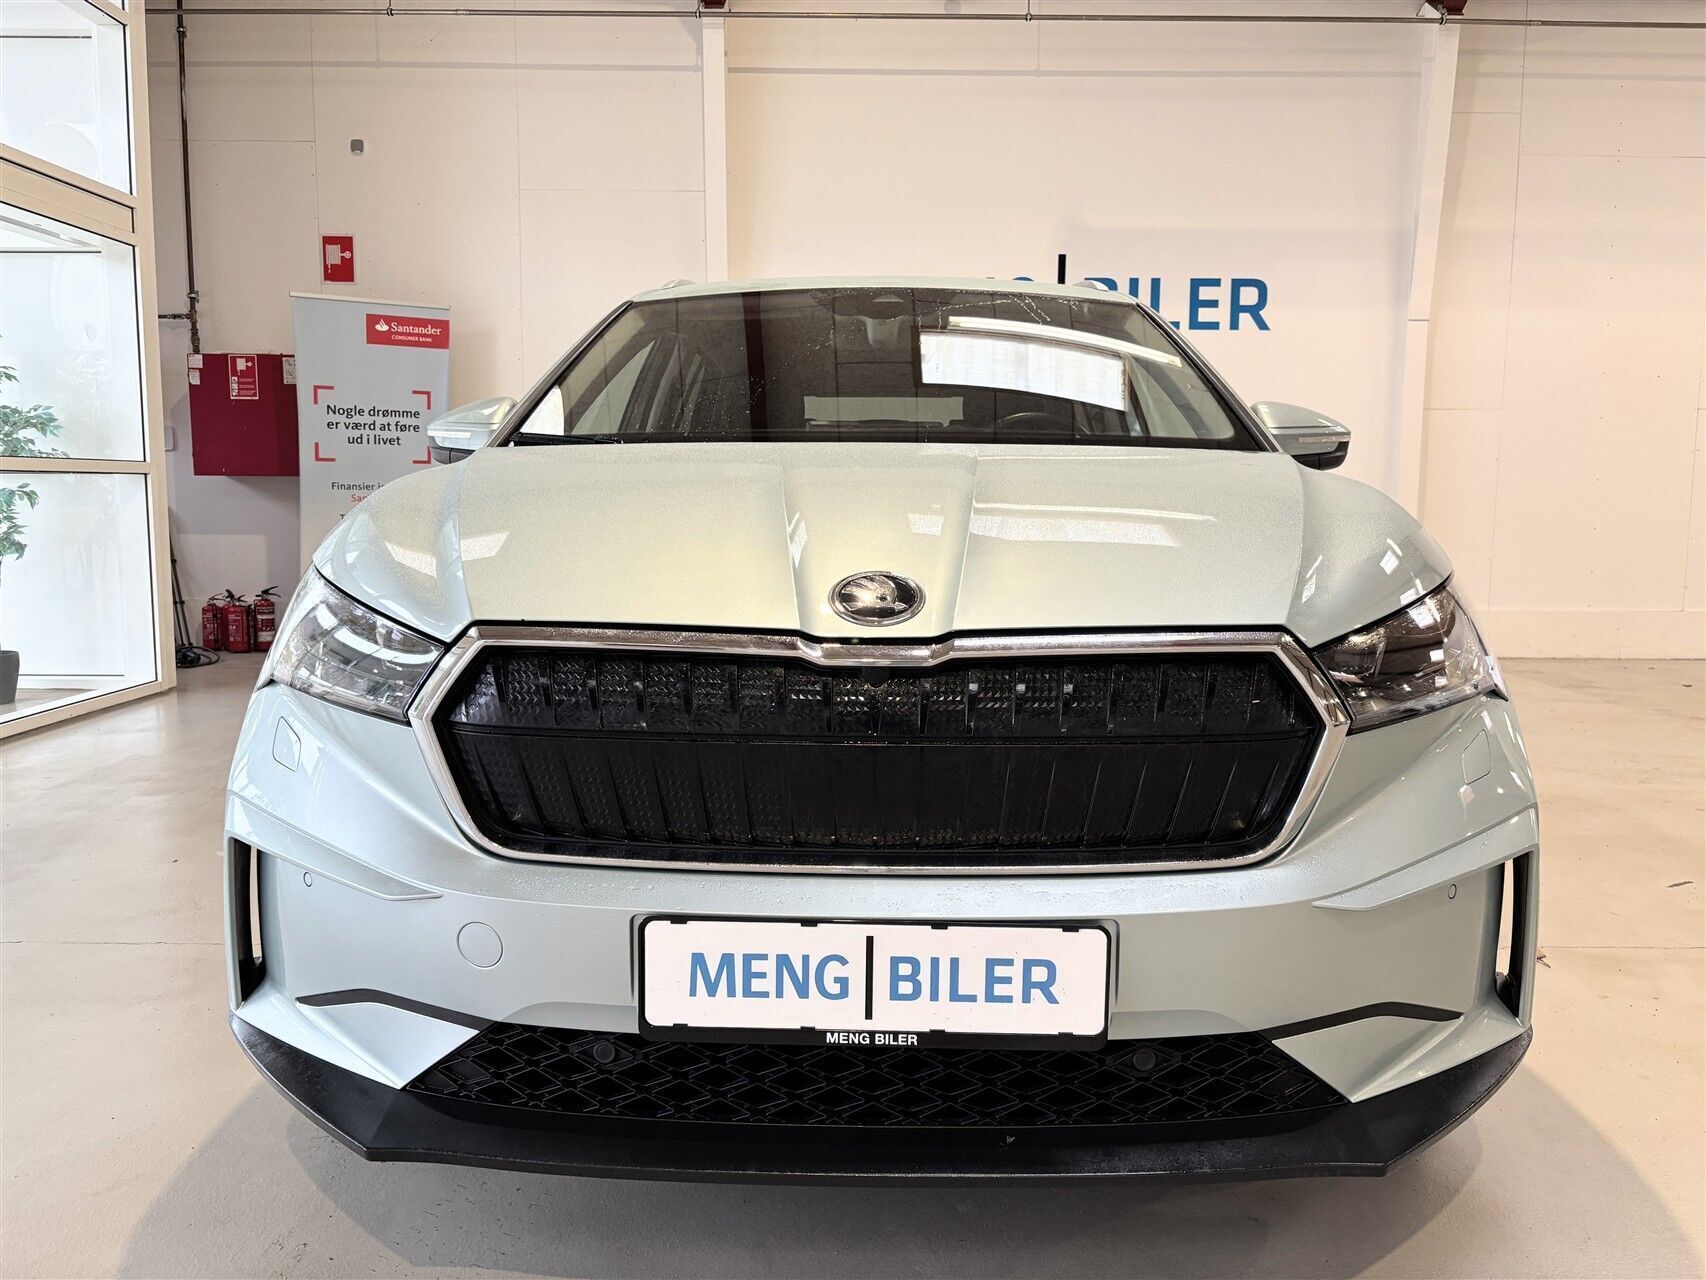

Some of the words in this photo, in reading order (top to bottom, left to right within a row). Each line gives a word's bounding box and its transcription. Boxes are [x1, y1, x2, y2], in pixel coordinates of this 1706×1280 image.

[1084, 277, 1270, 331] LER
[390, 322, 442, 335] Santander
[326, 404, 365, 419] Nogle
[368, 406, 420, 419] drømme
[326, 421, 340, 430] er
[344, 420, 376, 431] værd
[379, 422, 392, 432] at
[395, 421, 420, 433] føre
[347, 433, 363, 445] ud
[367, 434, 370, 445] i
[373, 434, 401, 446] livet
[331, 481, 375, 491] Finansier
[688, 952, 850, 1001] MENG
[889, 955, 1060, 1005] BILER
[826, 1032, 870, 1044] MENG
[874, 1033, 918, 1046] BILER
